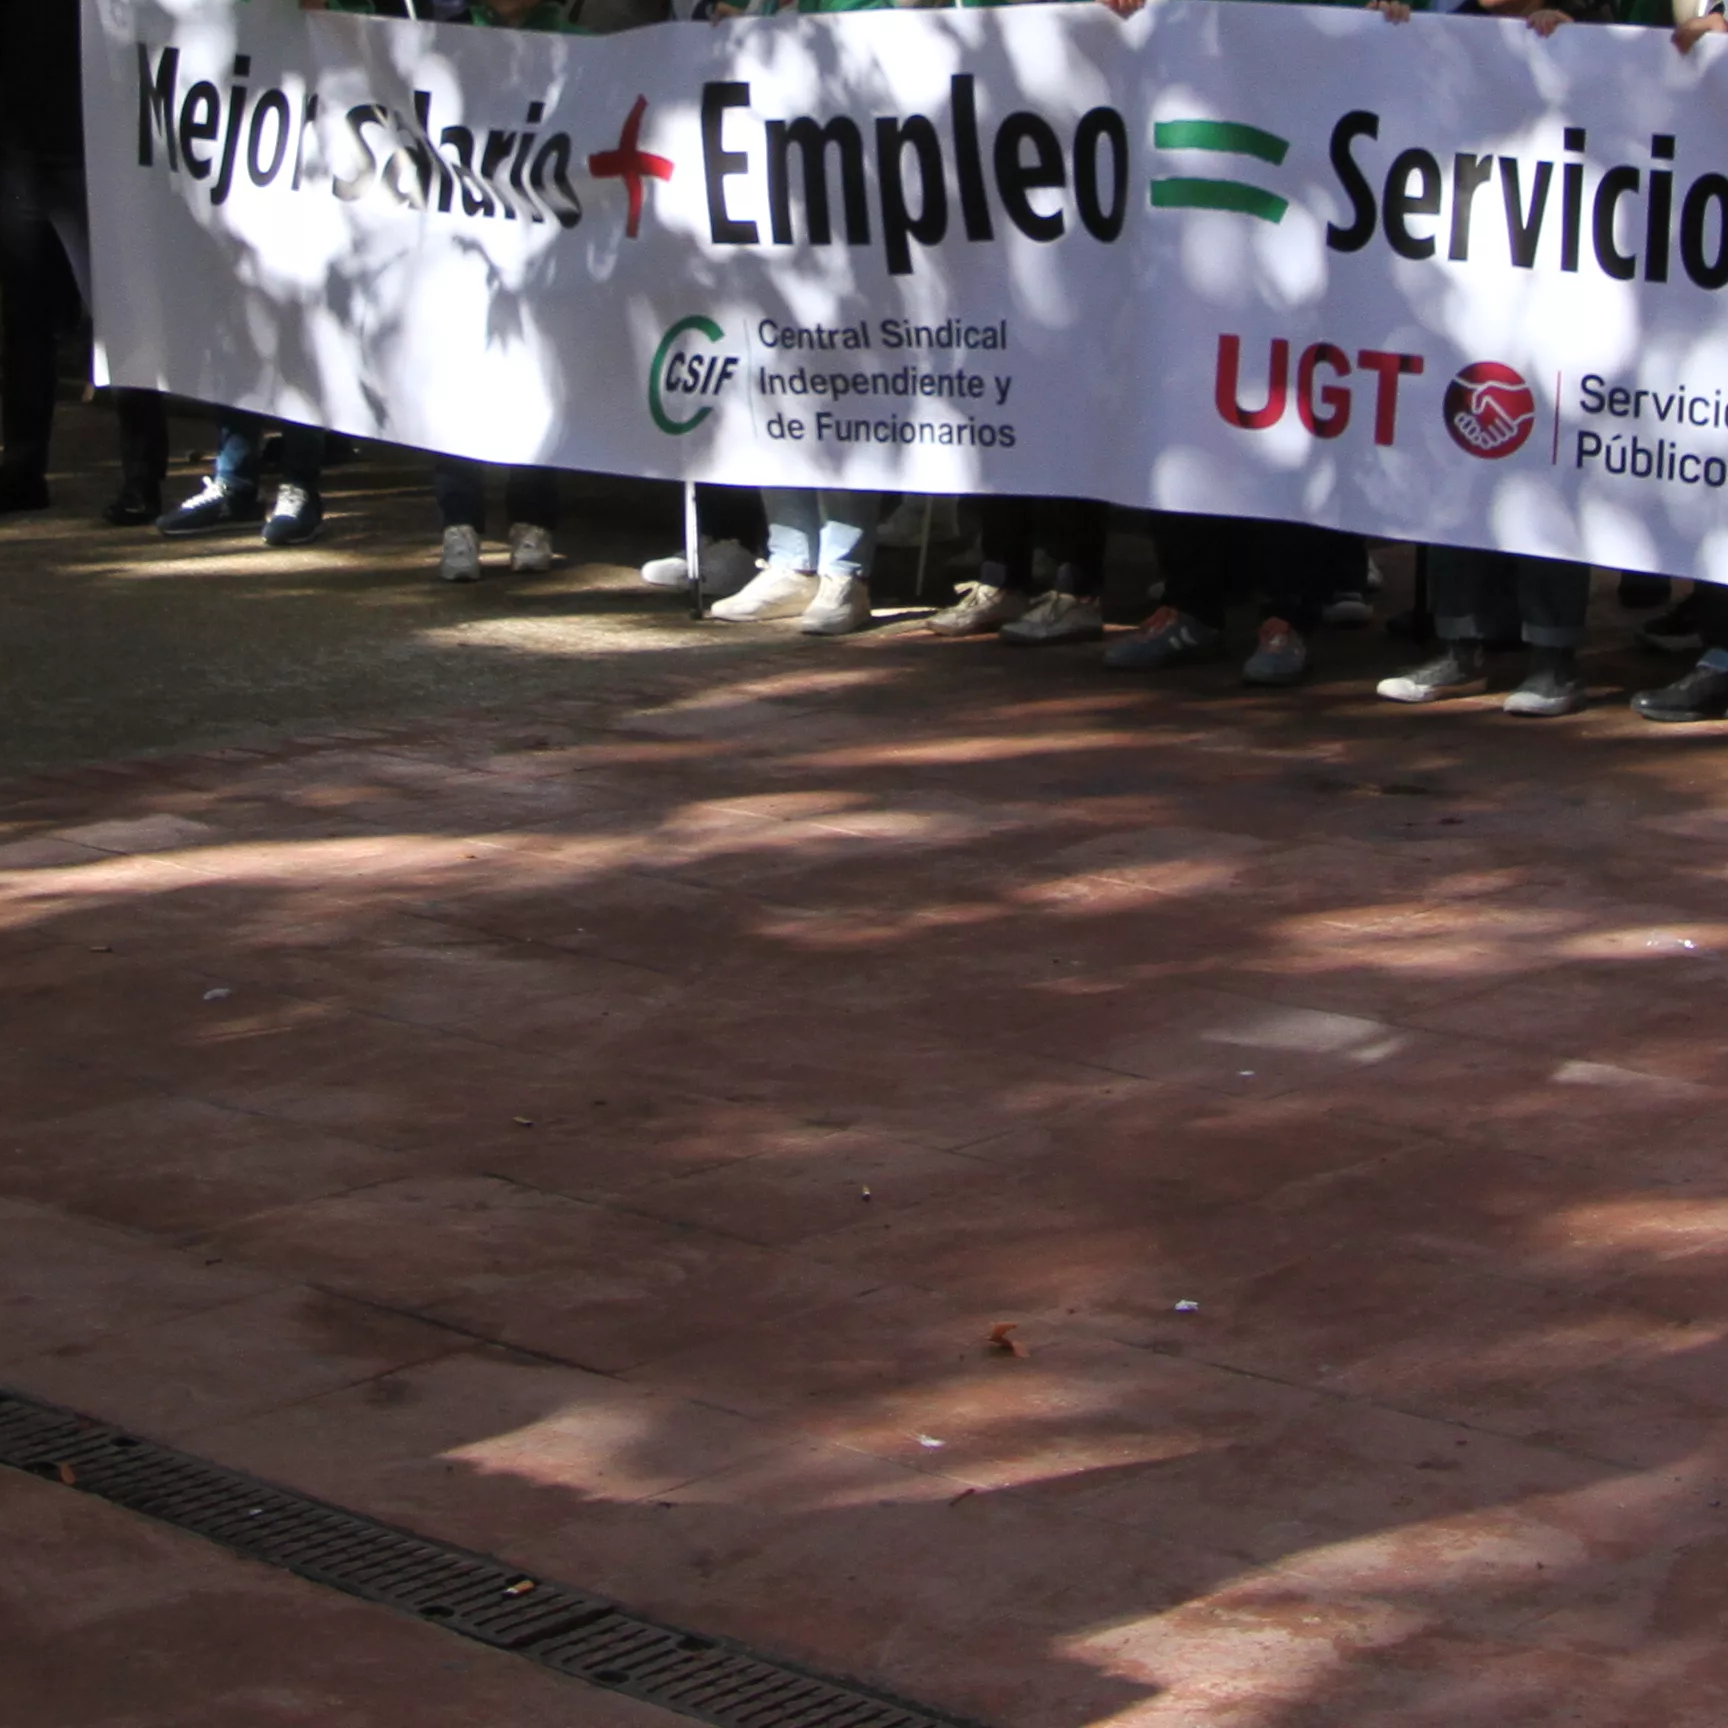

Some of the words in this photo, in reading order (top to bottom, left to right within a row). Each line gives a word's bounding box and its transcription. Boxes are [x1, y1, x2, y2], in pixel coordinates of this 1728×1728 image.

[136, 42, 316, 206] Mejor
[333, 89, 582, 229] Salario
[701, 75, 1129, 275] Empleo
[759, 319, 871, 352] Central
[881, 317, 1008, 352] Sindical
[665, 352, 738, 398] CSIF
[759, 367, 984, 403] Independiente
[994, 375, 1012, 407] y
[1213, 332, 1424, 447] UGT
[766, 412, 806, 442] de
[814, 412, 1016, 449] Funcionarios
